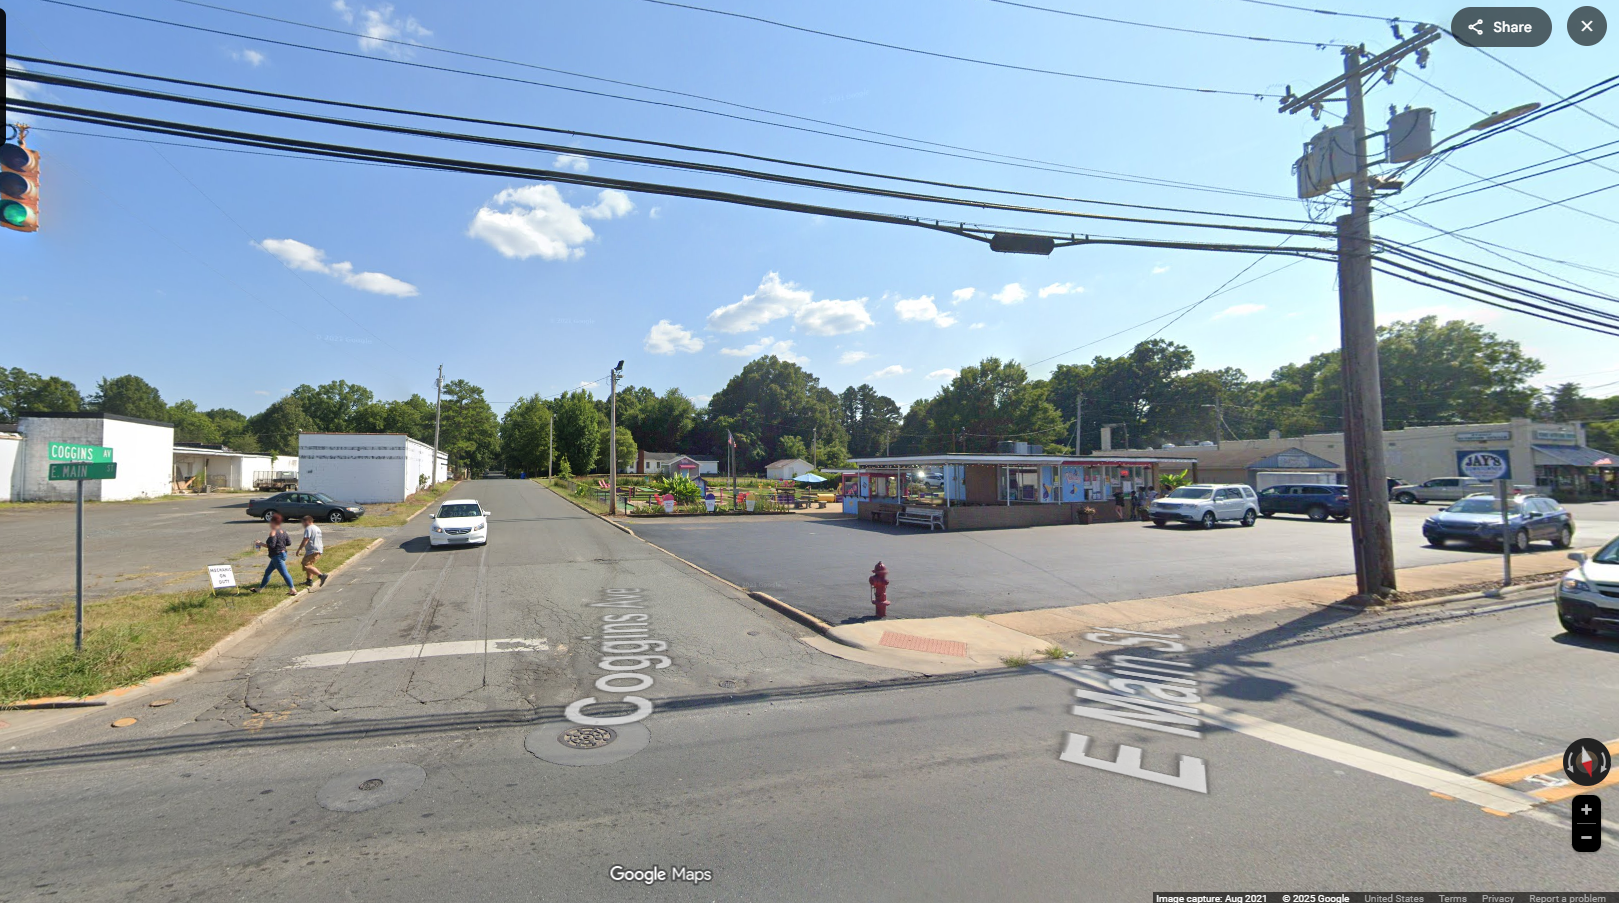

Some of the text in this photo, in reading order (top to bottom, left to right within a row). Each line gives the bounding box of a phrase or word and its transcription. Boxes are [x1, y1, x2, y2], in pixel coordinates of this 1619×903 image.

[51, 445, 111, 460] COGGINS AV
[1465, 454, 1502, 467] JAY'S
[62, 465, 88, 478] MAIN
[106, 464, 114, 472] ST
